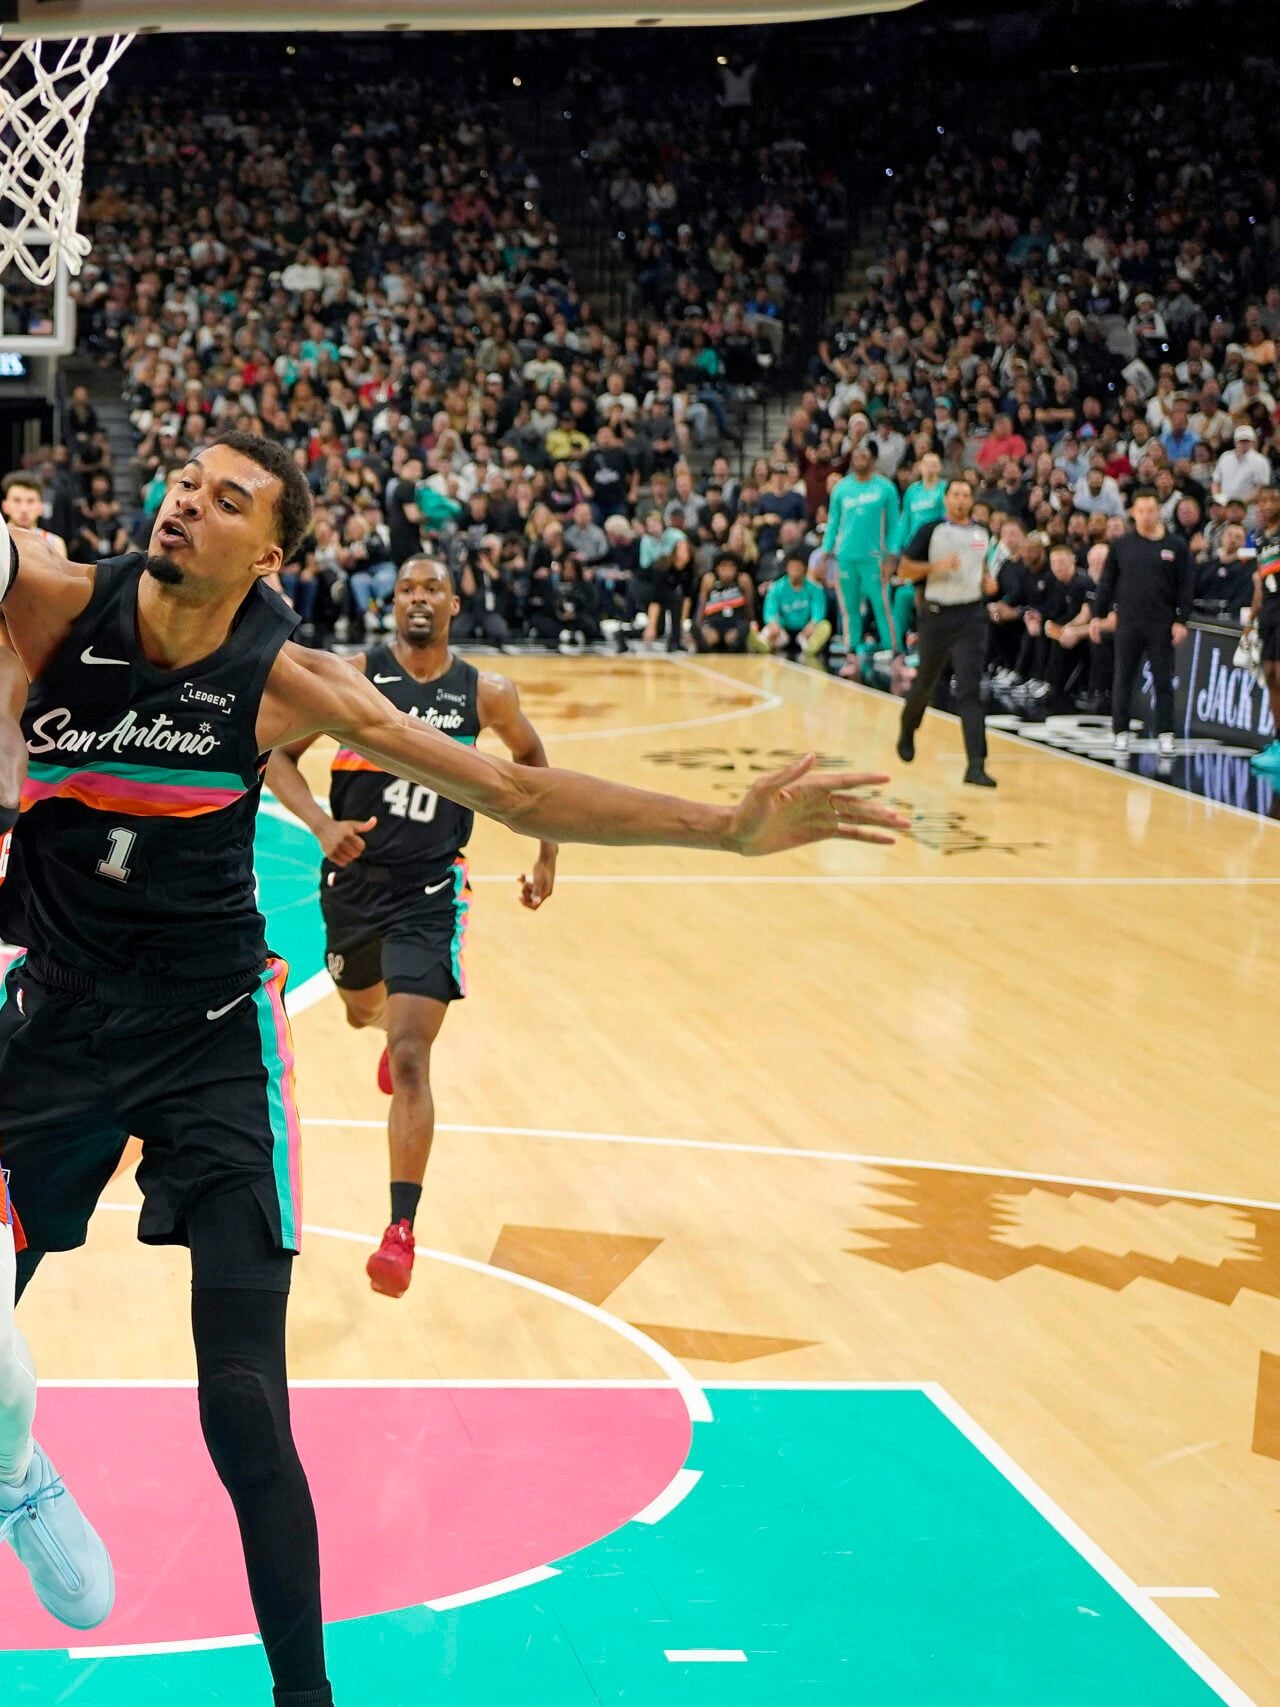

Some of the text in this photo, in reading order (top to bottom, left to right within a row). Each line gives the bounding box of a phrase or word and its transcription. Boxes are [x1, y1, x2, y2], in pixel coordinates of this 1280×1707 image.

[188, 688, 227, 707] LEDGER
[1197, 647, 1257, 731] JACK
[26, 707, 221, 756] San Antonio
[382, 777, 439, 824] 40
[94, 826, 138, 884] 1
